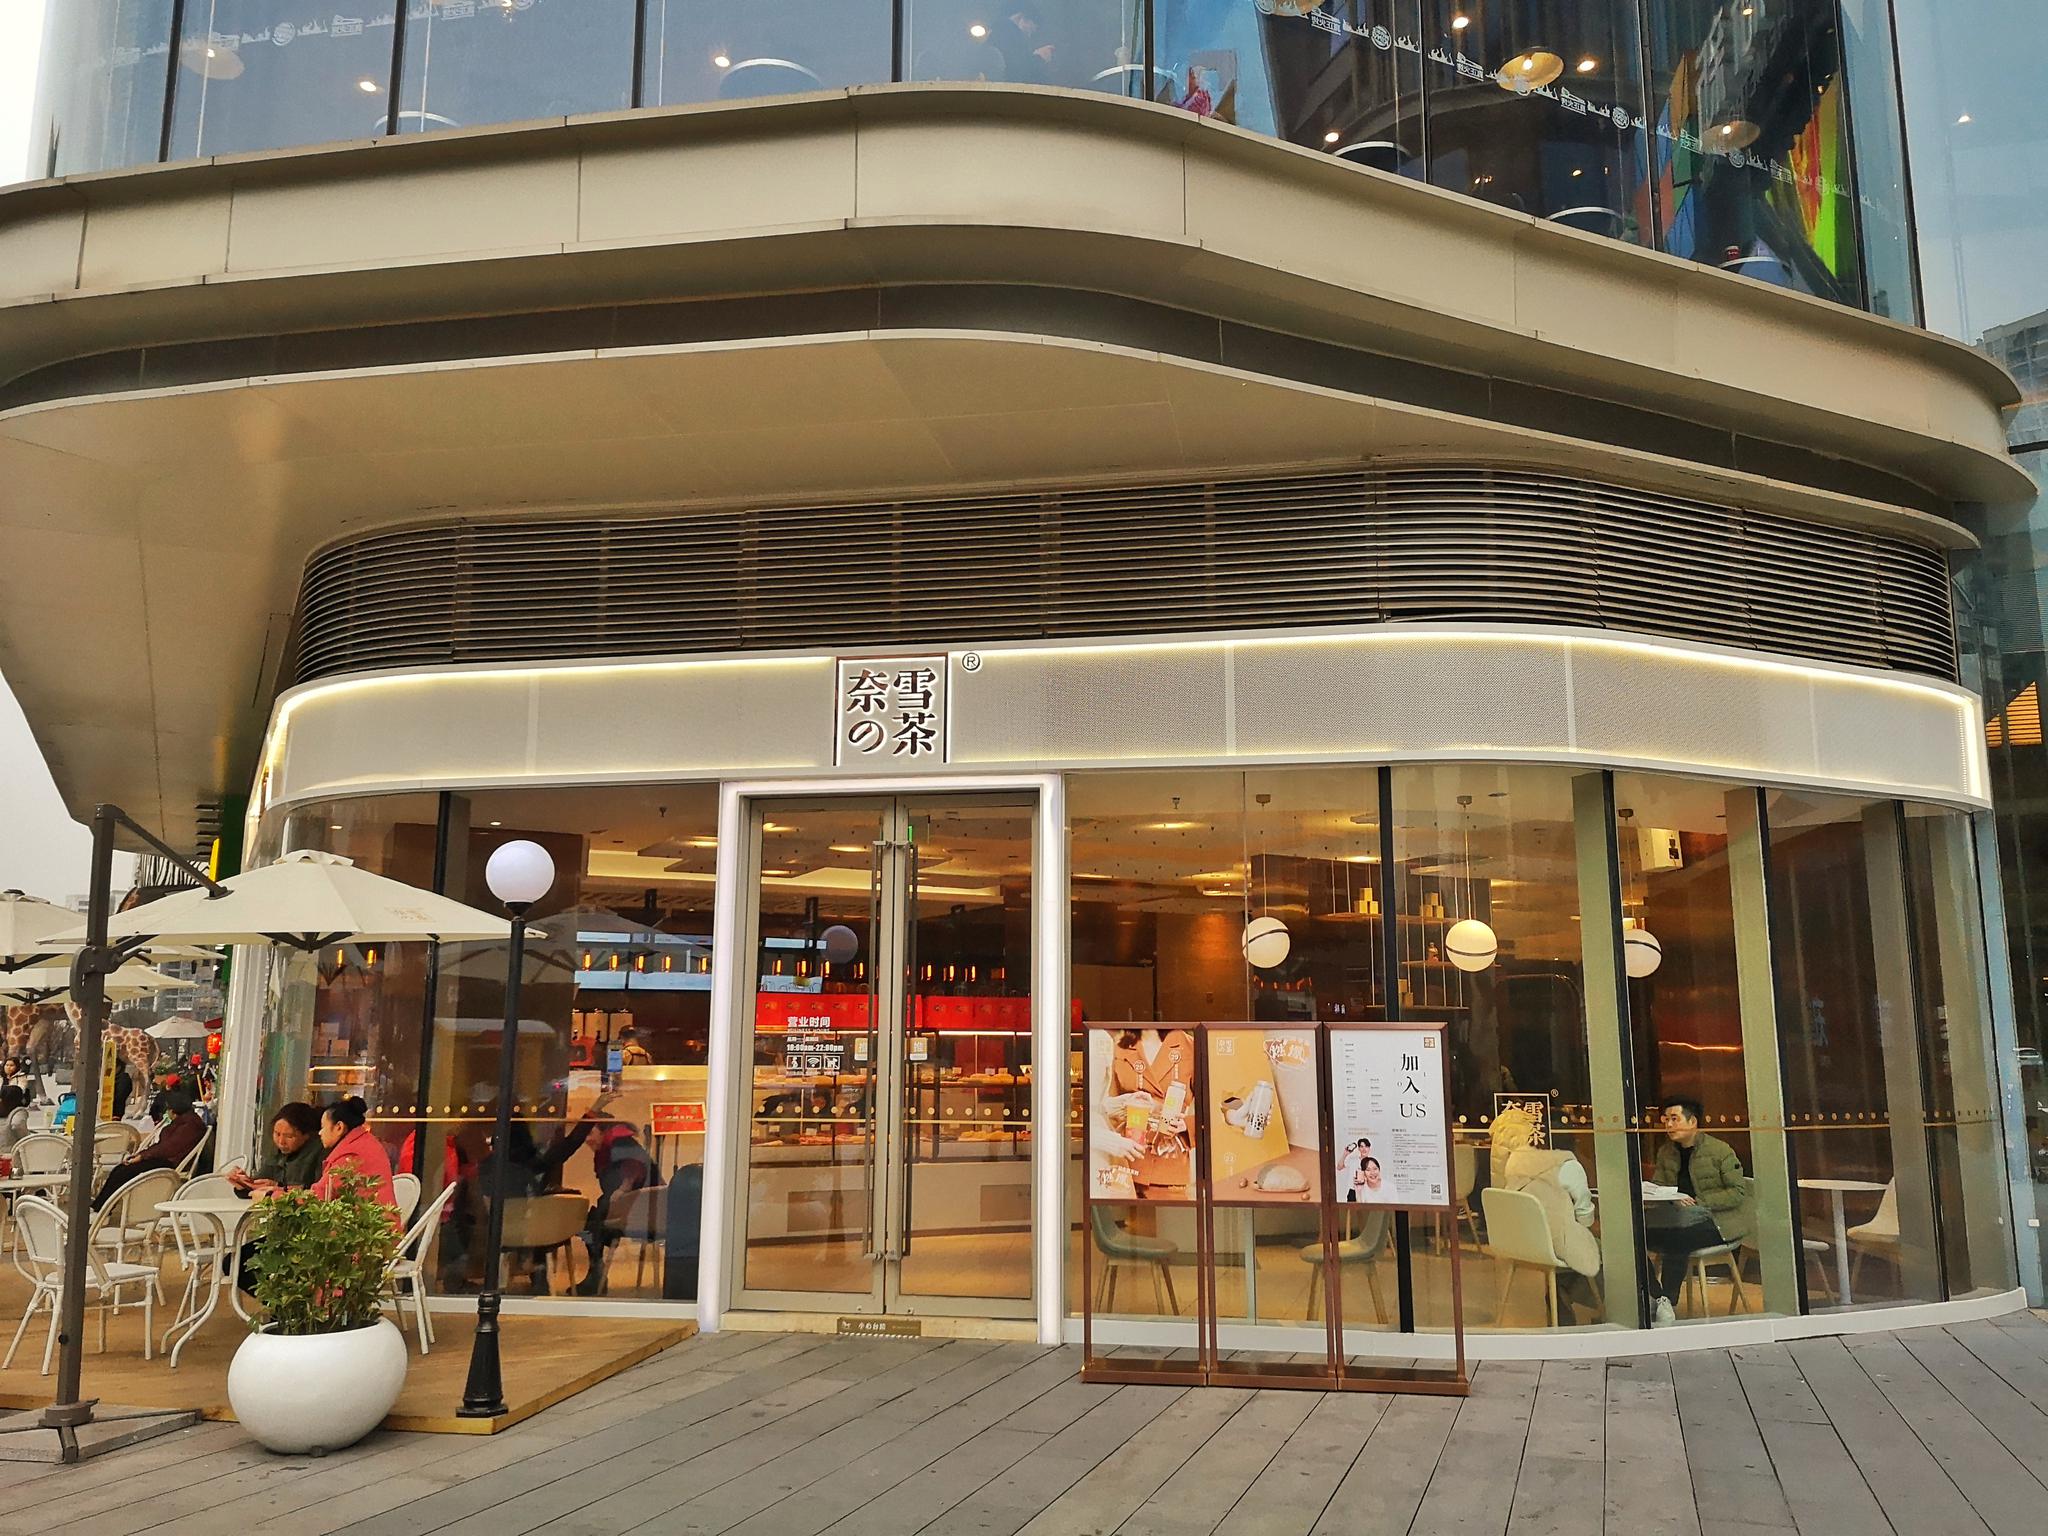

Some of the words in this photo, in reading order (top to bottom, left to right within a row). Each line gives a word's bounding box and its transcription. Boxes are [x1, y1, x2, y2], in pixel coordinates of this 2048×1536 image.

[846, 667, 936, 712] 奈雪
[848, 712, 937, 755] の茶
[787, 1016, 831, 1028] 营业时间
[1400, 1053, 1420, 1094] 加入
[1400, 1102, 1427, 1118] US
